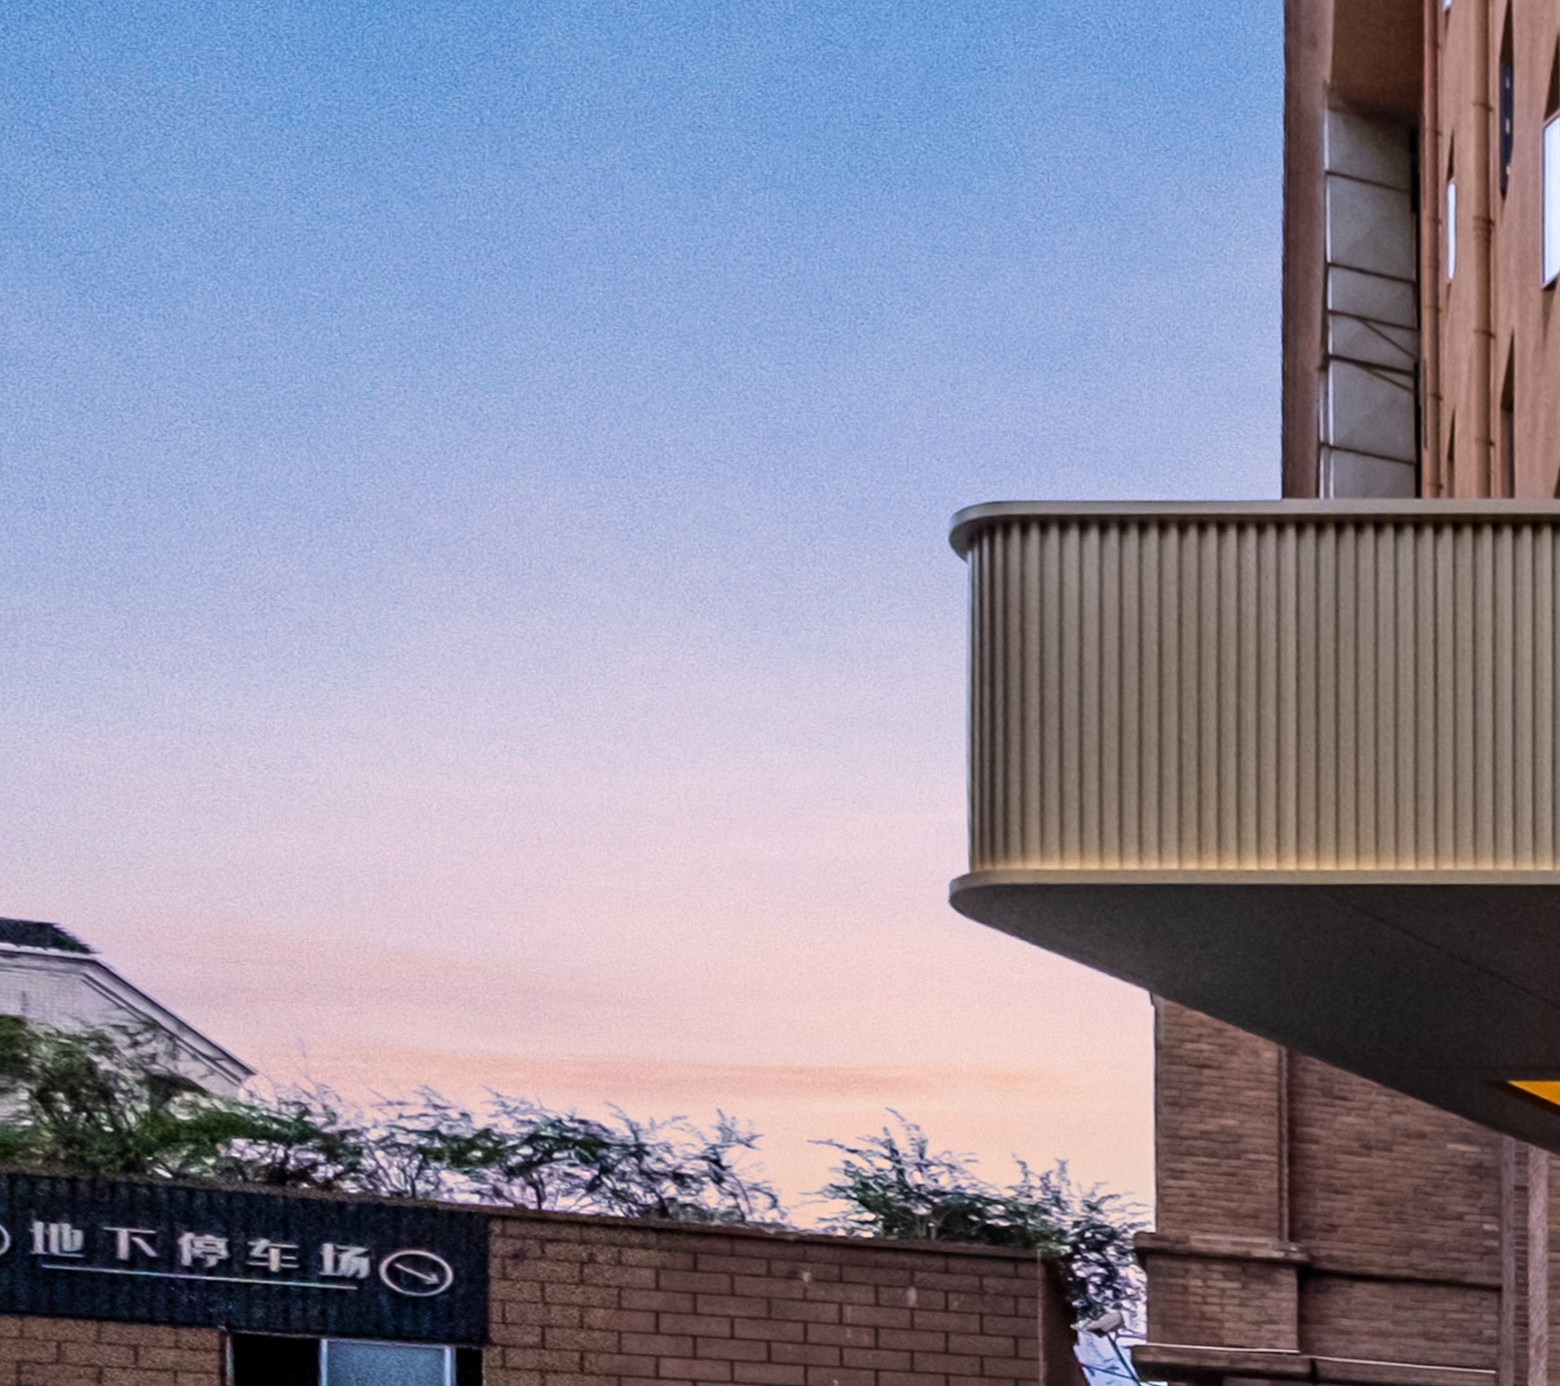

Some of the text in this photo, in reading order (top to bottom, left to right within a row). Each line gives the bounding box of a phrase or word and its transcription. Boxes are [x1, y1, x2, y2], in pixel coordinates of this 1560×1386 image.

[30, 1219, 370, 1280] 地下停车场
